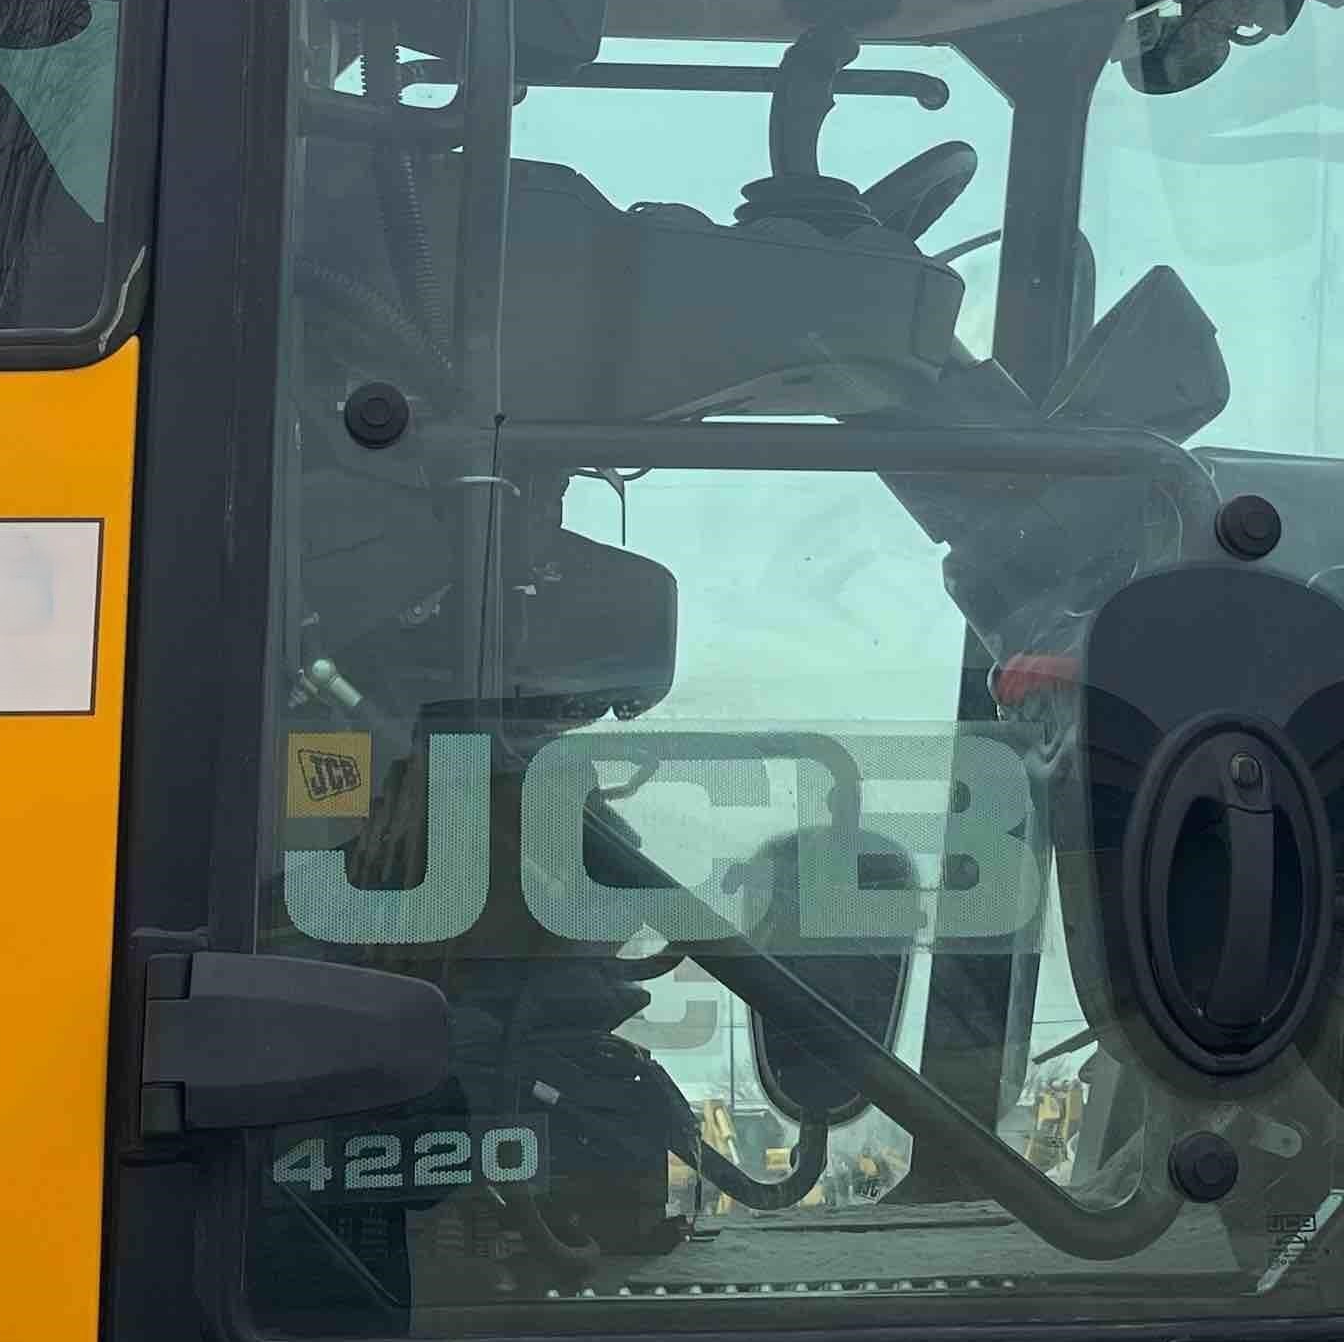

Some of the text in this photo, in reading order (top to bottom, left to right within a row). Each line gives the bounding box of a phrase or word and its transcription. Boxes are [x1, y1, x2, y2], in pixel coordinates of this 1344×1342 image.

[309, 754, 359, 796] JCB
[283, 731, 1044, 945] JCB
[272, 1126, 539, 1192] 4220
